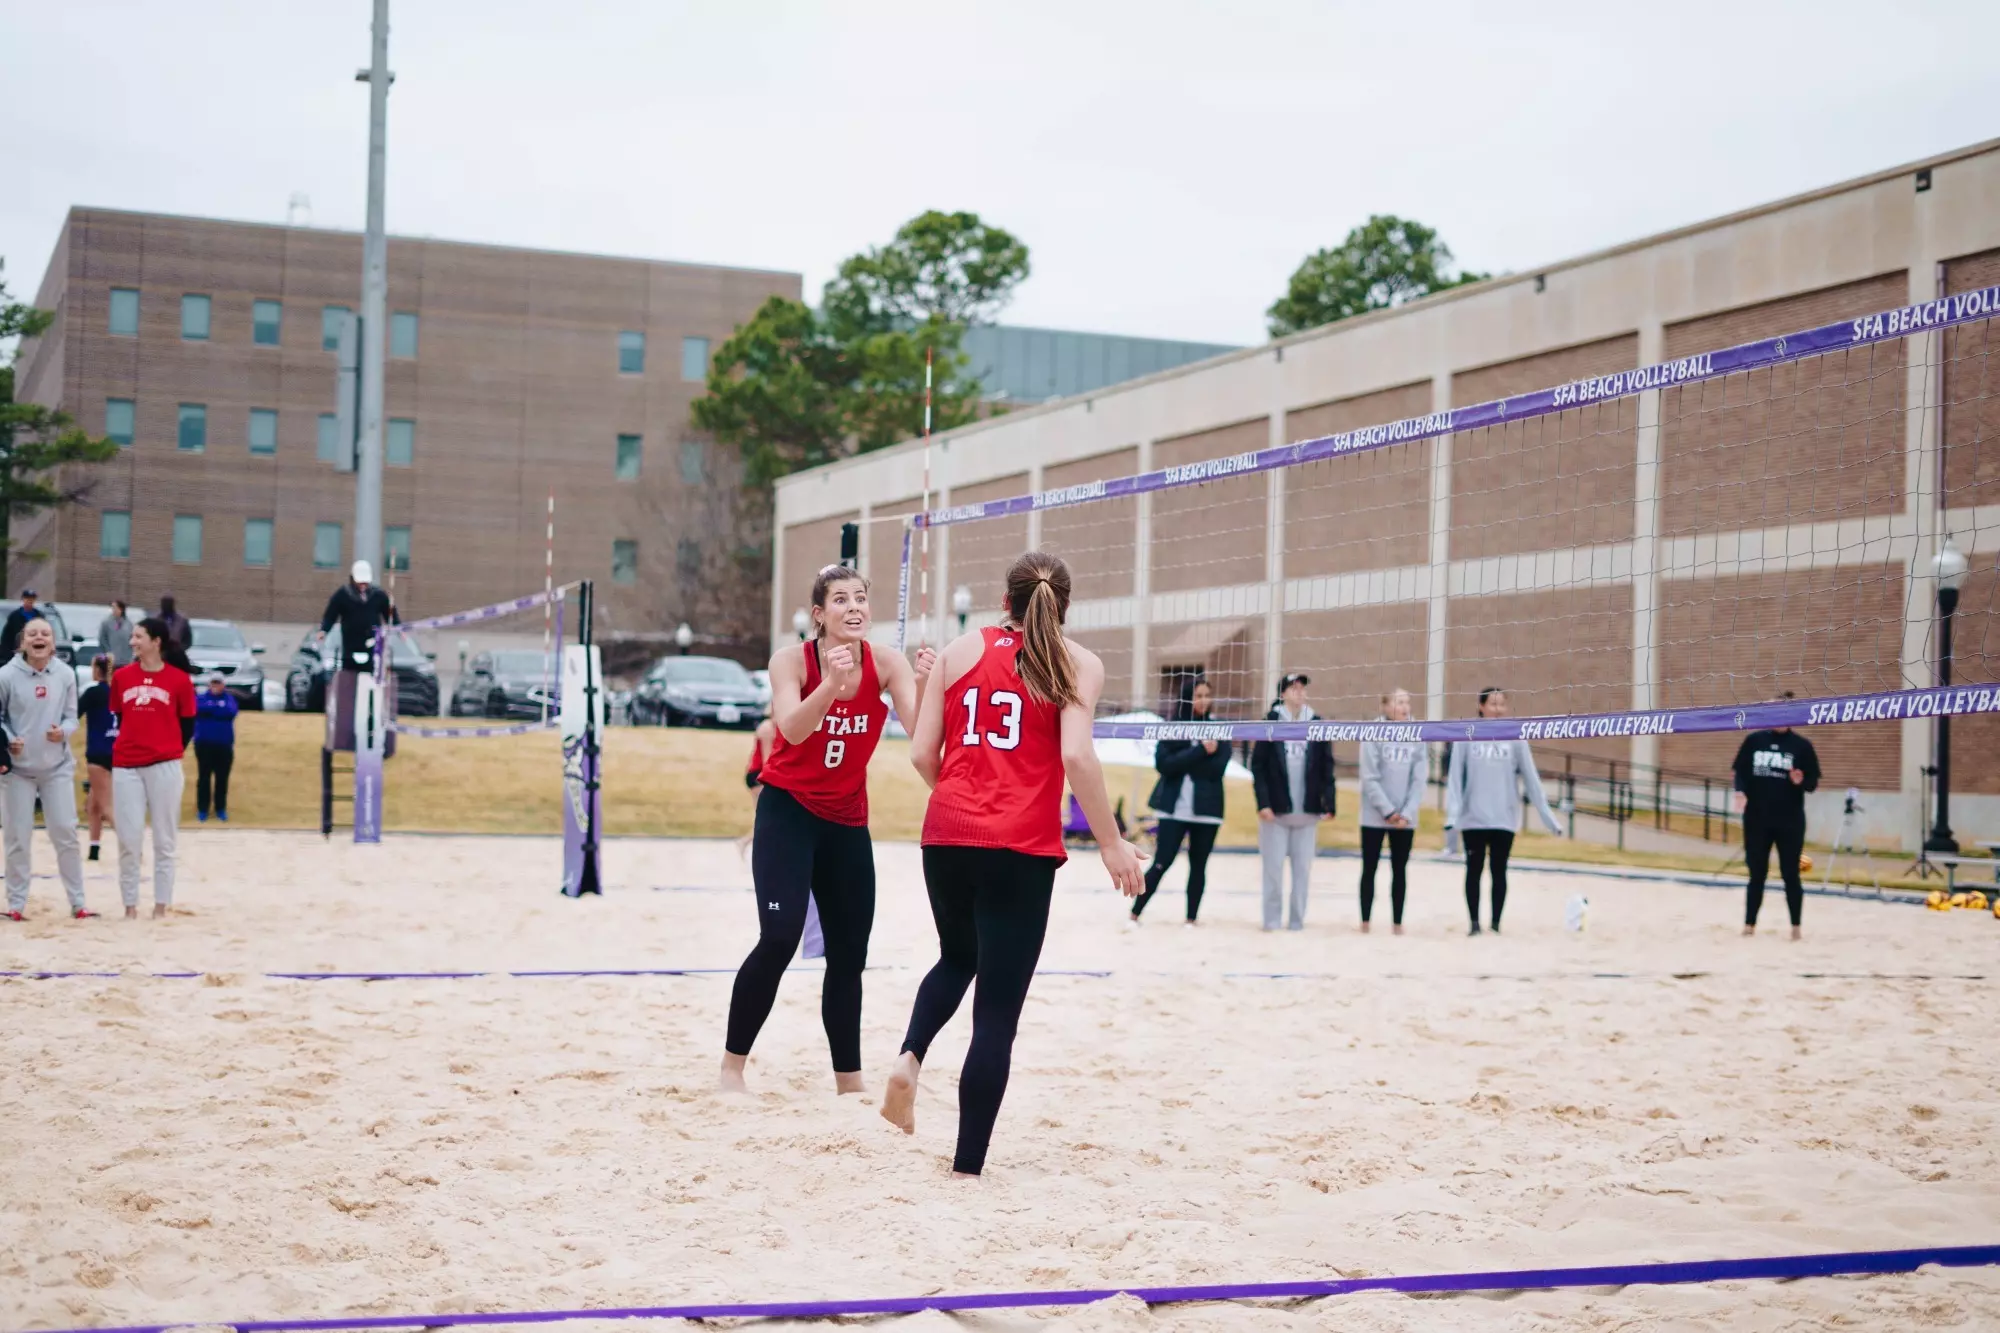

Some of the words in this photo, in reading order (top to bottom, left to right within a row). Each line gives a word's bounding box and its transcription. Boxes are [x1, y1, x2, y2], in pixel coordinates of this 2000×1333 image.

[1852, 317, 1883, 341] SFA
[1888, 299, 1949, 333] BEACH
[1954, 287, 2000, 318] VOLL
[1553, 385, 1577, 407] SFA
[1579, 374, 1624, 402] BEACH
[1626, 354, 1714, 391] VOLLEYBALL
[1333, 434, 1351, 452] SFA
[1352, 426, 1387, 449] BEACH
[1386, 411, 1453, 441] VOLLEYBALL
[1165, 467, 1179, 484] SFA
[1180, 462, 1207, 481] BEACH
[1206, 452, 1258, 476] VOLLEYBALL
[962, 686, 1023, 750] 13
[1807, 702, 1837, 725] SFA
[1841, 697, 1902, 722] BEACH
[1143, 726, 1157, 740] SFA
[1157, 726, 1185, 740] BEACH
[1184, 725, 1234, 740] VOLLEYBALL
[1305, 725, 1324, 742] SFA
[1324, 725, 1358, 741] BEACH
[1358, 725, 1423, 742] VOLLEYBALL
[1519, 722, 1542, 740] SFA
[1543, 719, 1588, 739] BEACH
[1590, 714, 1674, 737] VOLLEYBALL
[824, 740, 846, 769] 8
